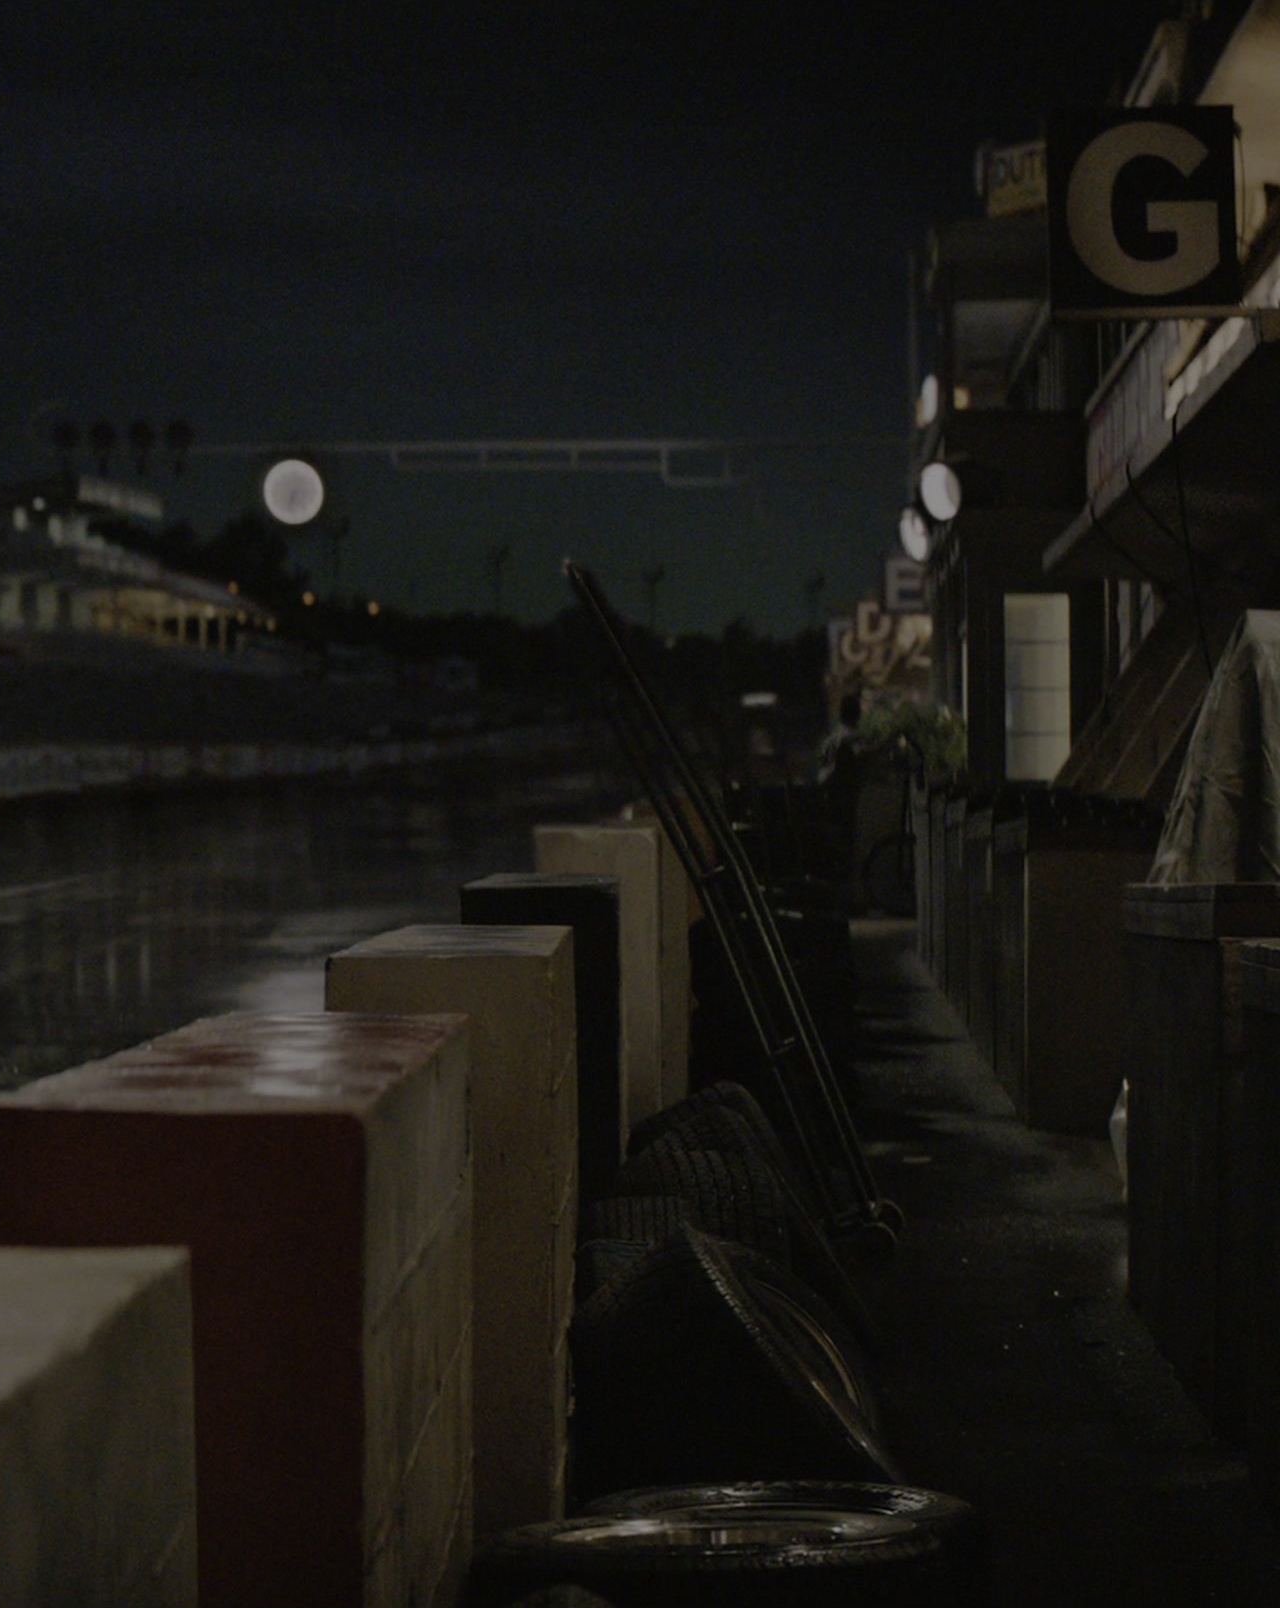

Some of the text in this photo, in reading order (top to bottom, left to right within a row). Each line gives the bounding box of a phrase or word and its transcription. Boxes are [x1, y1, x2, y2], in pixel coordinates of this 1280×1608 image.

[995, 151, 1045, 188] DUT
[1066, 120, 1220, 296] G
[886, 559, 924, 609] E
[857, 601, 893, 643] D
